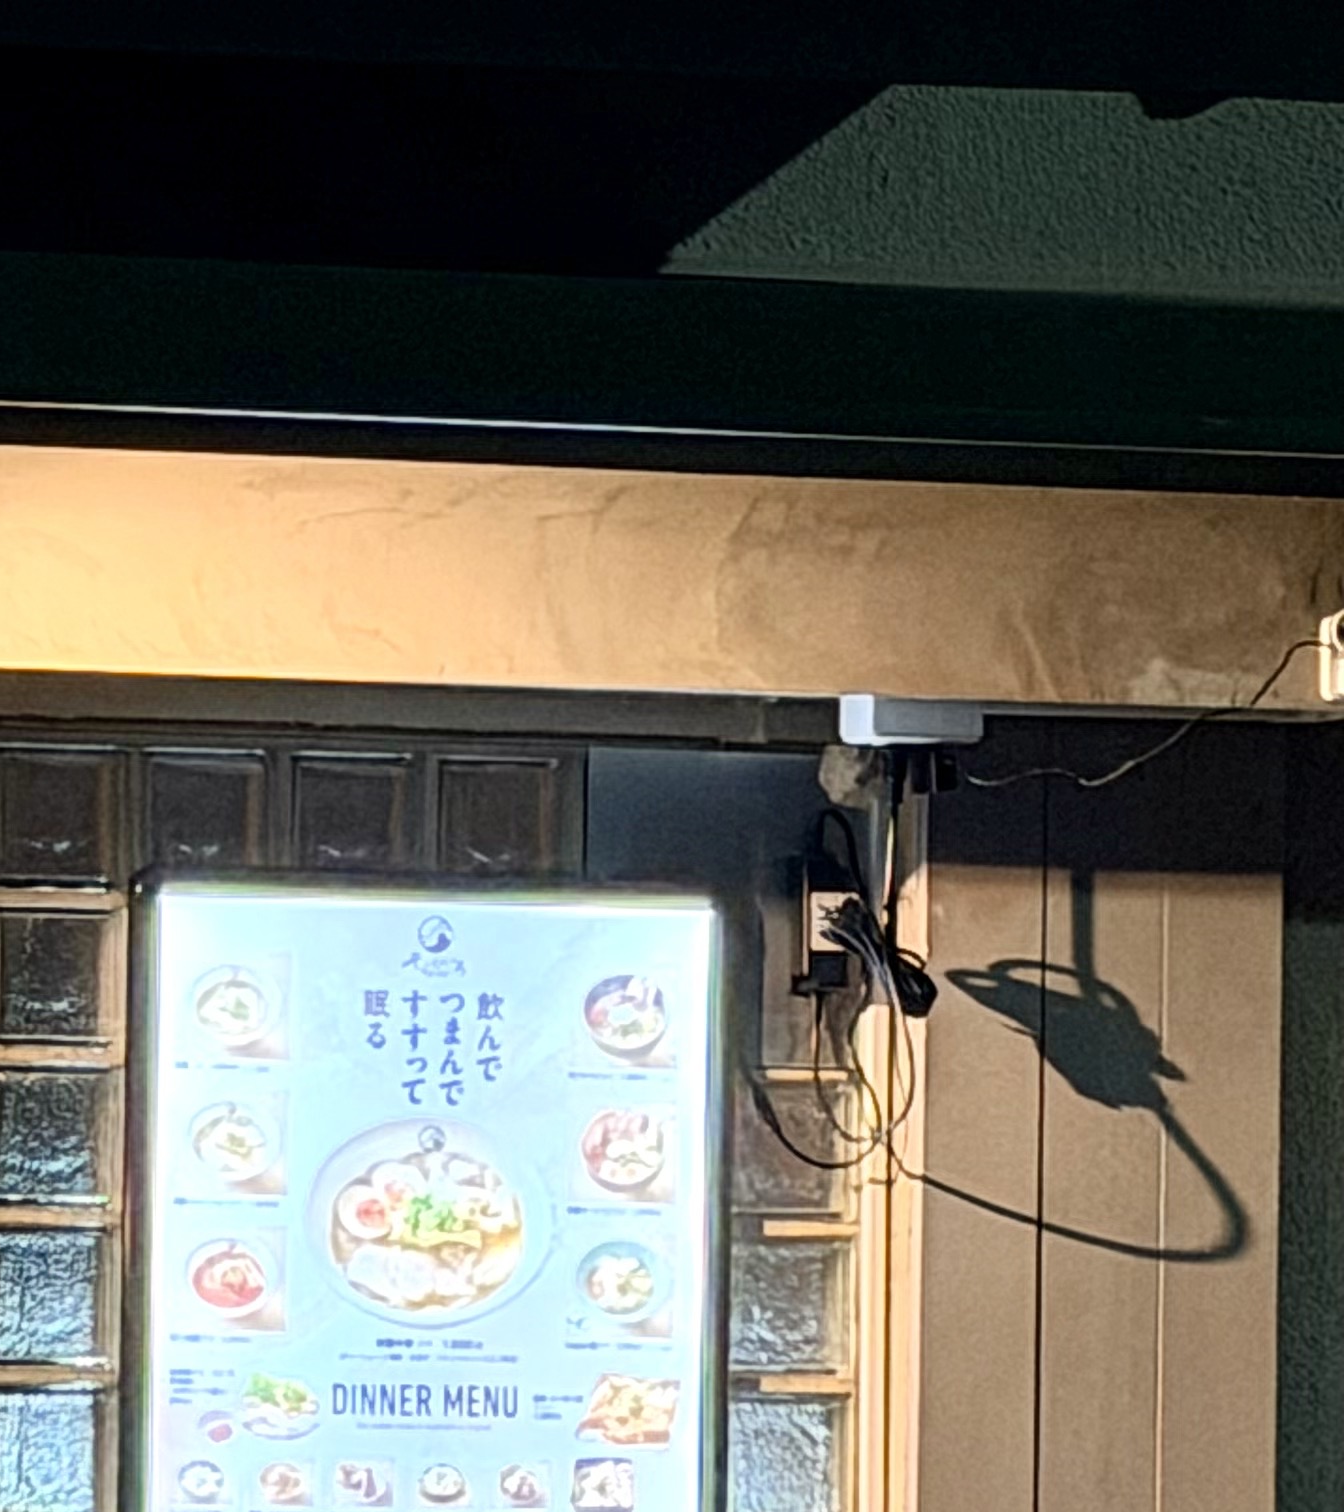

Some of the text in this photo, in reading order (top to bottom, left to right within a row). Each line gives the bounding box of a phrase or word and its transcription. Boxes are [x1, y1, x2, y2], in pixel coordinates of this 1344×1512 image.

[363, 989, 391, 1049] 眠る
[400, 989, 428, 1105] すすって
[439, 992, 466, 1106] つまんで
[475, 991, 505, 1082] 飲んで
[331, 1383, 432, 1417] DINNER
[443, 1384, 519, 1419] MENU
